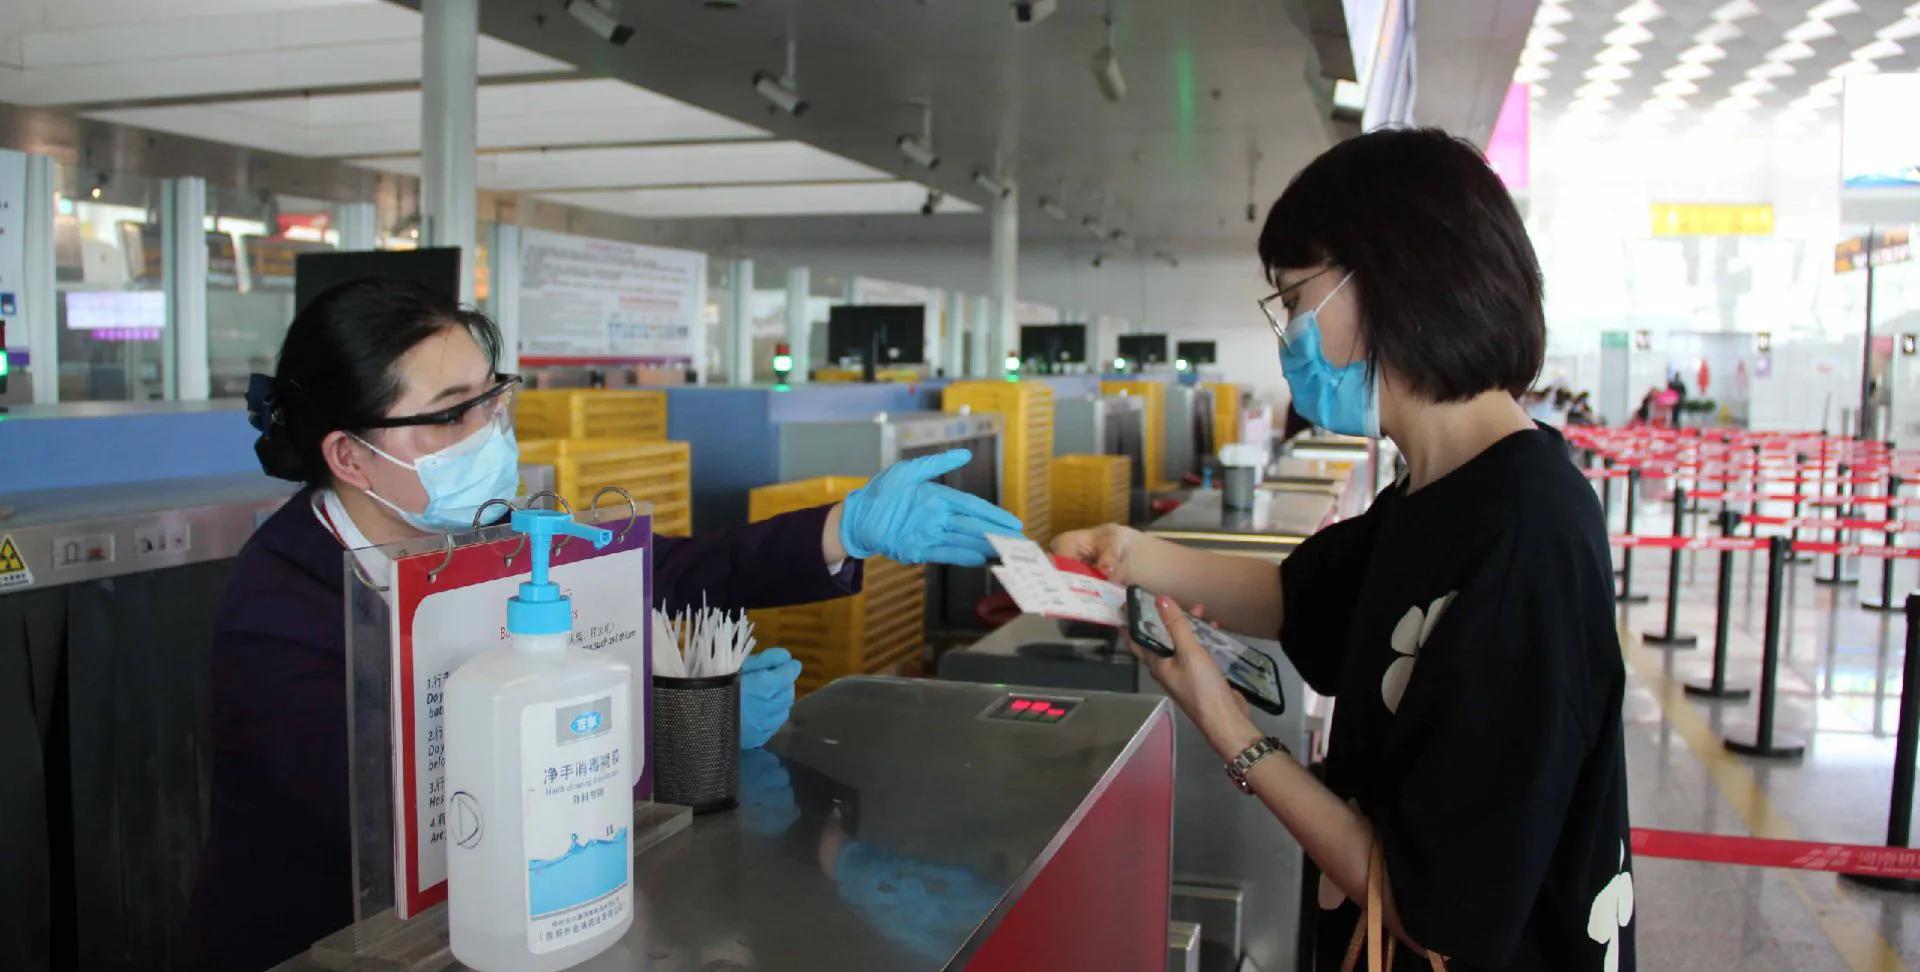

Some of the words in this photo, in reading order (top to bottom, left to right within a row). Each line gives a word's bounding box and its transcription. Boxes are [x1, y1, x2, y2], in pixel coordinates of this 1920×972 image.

[544, 748, 619, 784] 净手消毒凝胶
